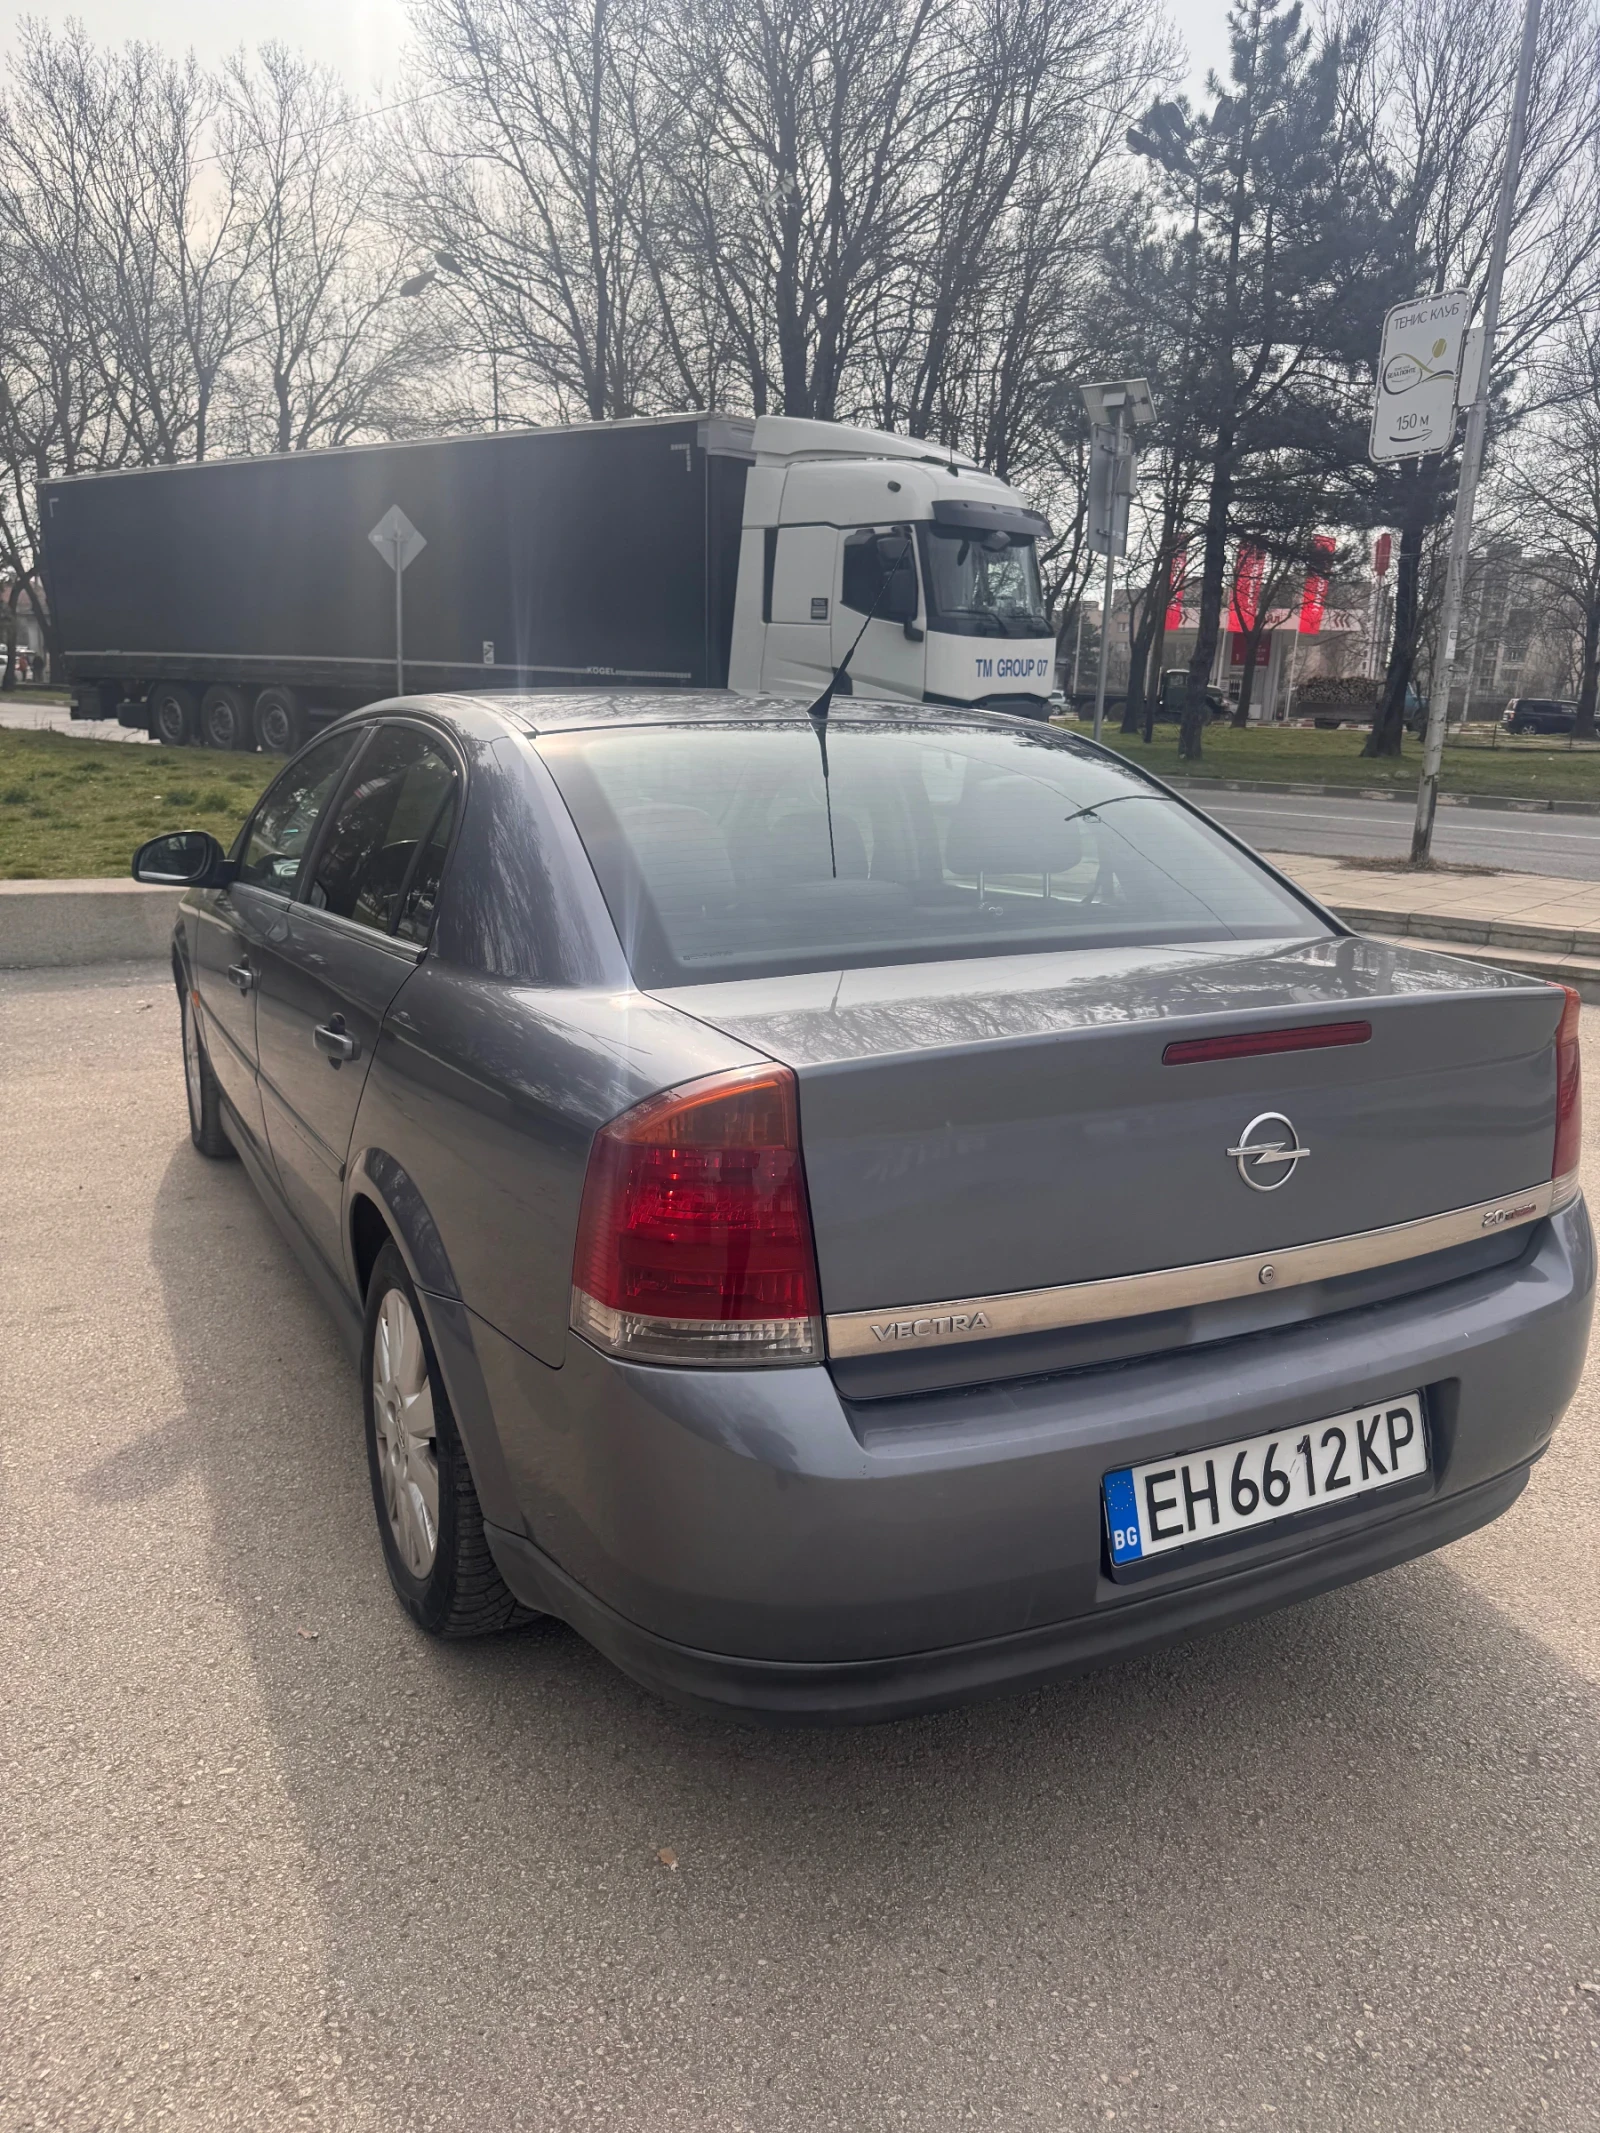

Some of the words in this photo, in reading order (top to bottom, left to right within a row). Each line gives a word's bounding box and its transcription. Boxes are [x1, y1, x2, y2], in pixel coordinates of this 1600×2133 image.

[1394, 311, 1428, 330] ТЕНИС
[1430, 302, 1460, 320] КЛУБ
[1396, 413, 1418, 431] 150
[975, 658, 993, 678] TM
[996, 658, 1035, 677] GROUP
[1036, 658, 1049, 677] 07
[870, 1311, 992, 1342] VECTRA
[1113, 1526, 1138, 1550] BG
